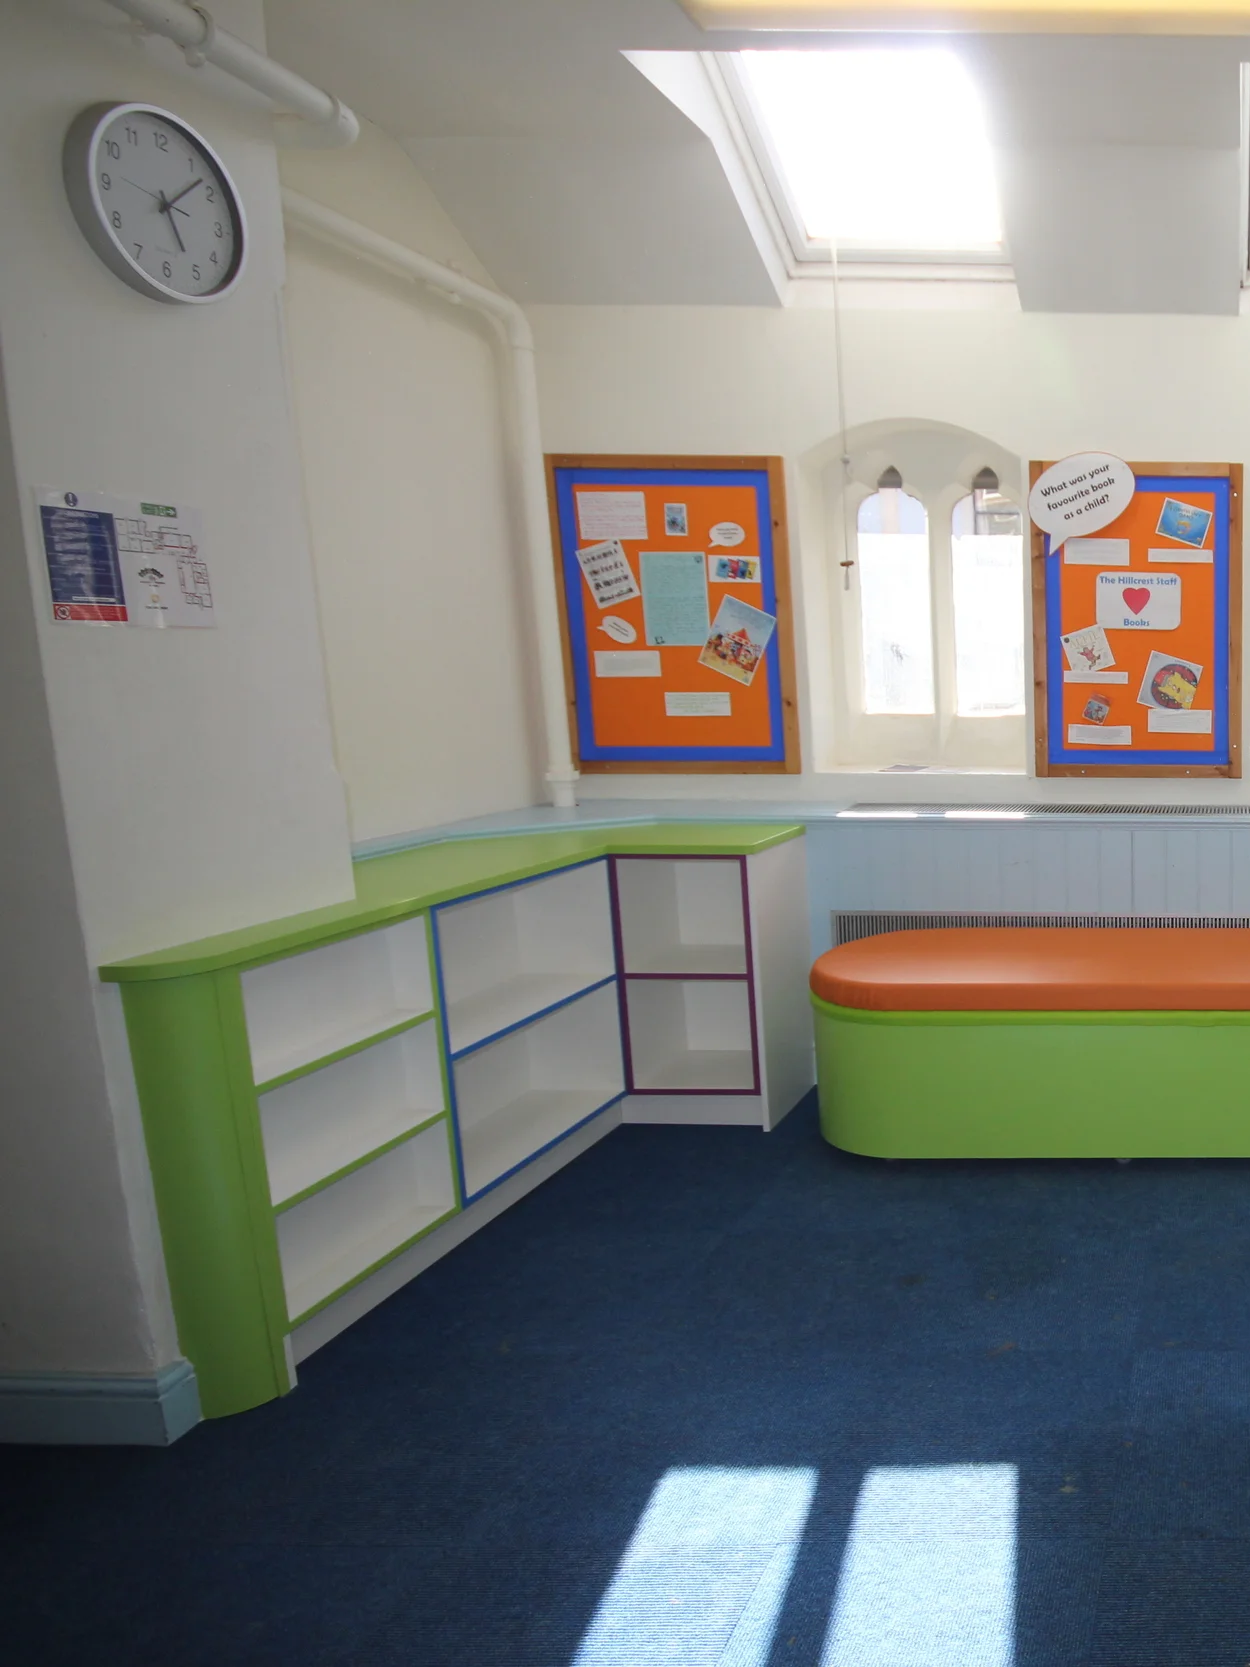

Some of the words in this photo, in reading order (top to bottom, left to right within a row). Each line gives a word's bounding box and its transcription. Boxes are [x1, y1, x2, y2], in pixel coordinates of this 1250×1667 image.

[124, 126, 138, 147] 11
[152, 131, 169, 153] 12
[104, 139, 121, 160] 10
[187, 157, 194, 173] 1
[101, 172, 112, 191] 9
[205, 185, 216, 204] 2
[111, 210, 122, 230] 8
[213, 221, 223, 239] 3
[132, 242, 144, 260] 7
[208, 251, 219, 267] 4
[161, 260, 172, 279] 6
[191, 263, 201, 281] 5
[1040, 480, 1068, 497] What
[1069, 473, 1087, 486] was
[1088, 464, 1110, 480] your
[1046, 488, 1090, 511] favourite
[1090, 477, 1116, 492] book
[1063, 511, 1075, 521] as
[1076, 507, 1083, 516] a
[1084, 494, 1110, 512] child?
[1099, 575, 1116, 585] The
[1118, 576, 1154, 585] Hillcrest
[1156, 577, 1178, 586] Staff
[1123, 618, 1150, 627] Books
